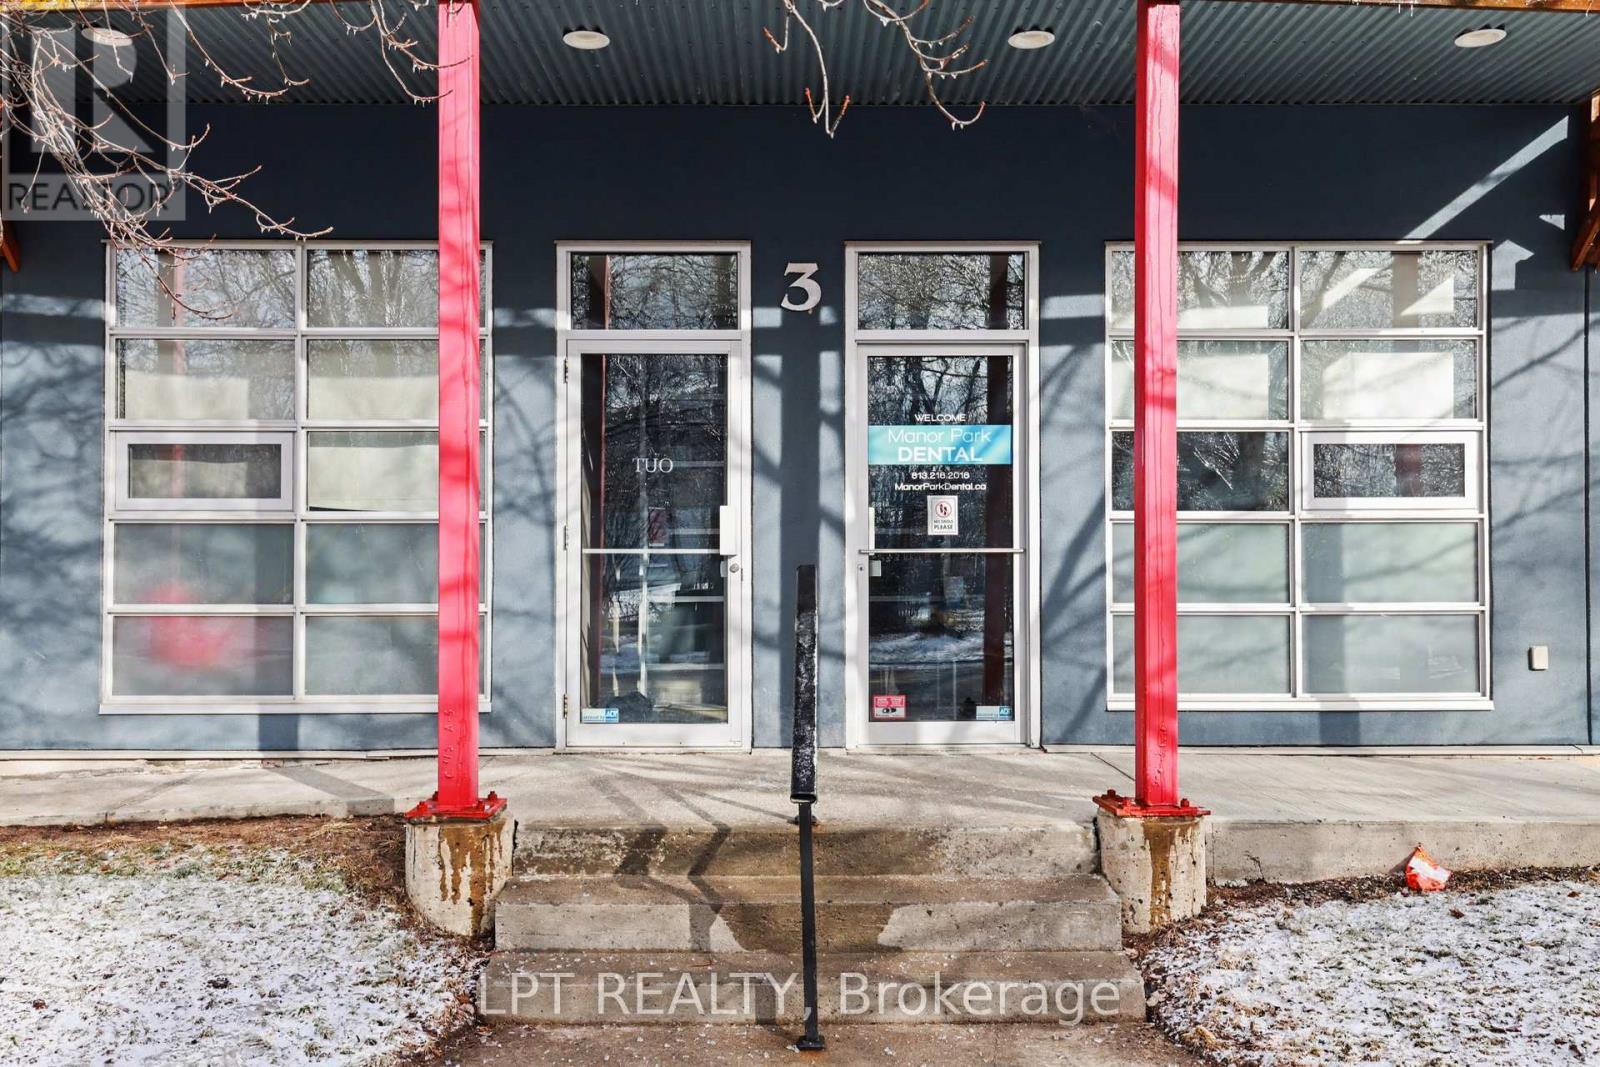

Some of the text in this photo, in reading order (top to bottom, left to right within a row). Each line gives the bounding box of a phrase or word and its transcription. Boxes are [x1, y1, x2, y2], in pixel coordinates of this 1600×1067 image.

[781, 262, 822, 312] 3
[914, 413, 966, 422] WELCOME
[888, 428, 992, 443] Manor Park
[897, 446, 983, 462] DENTAL
[894, 482, 988, 491] ManorParkDental.ca
